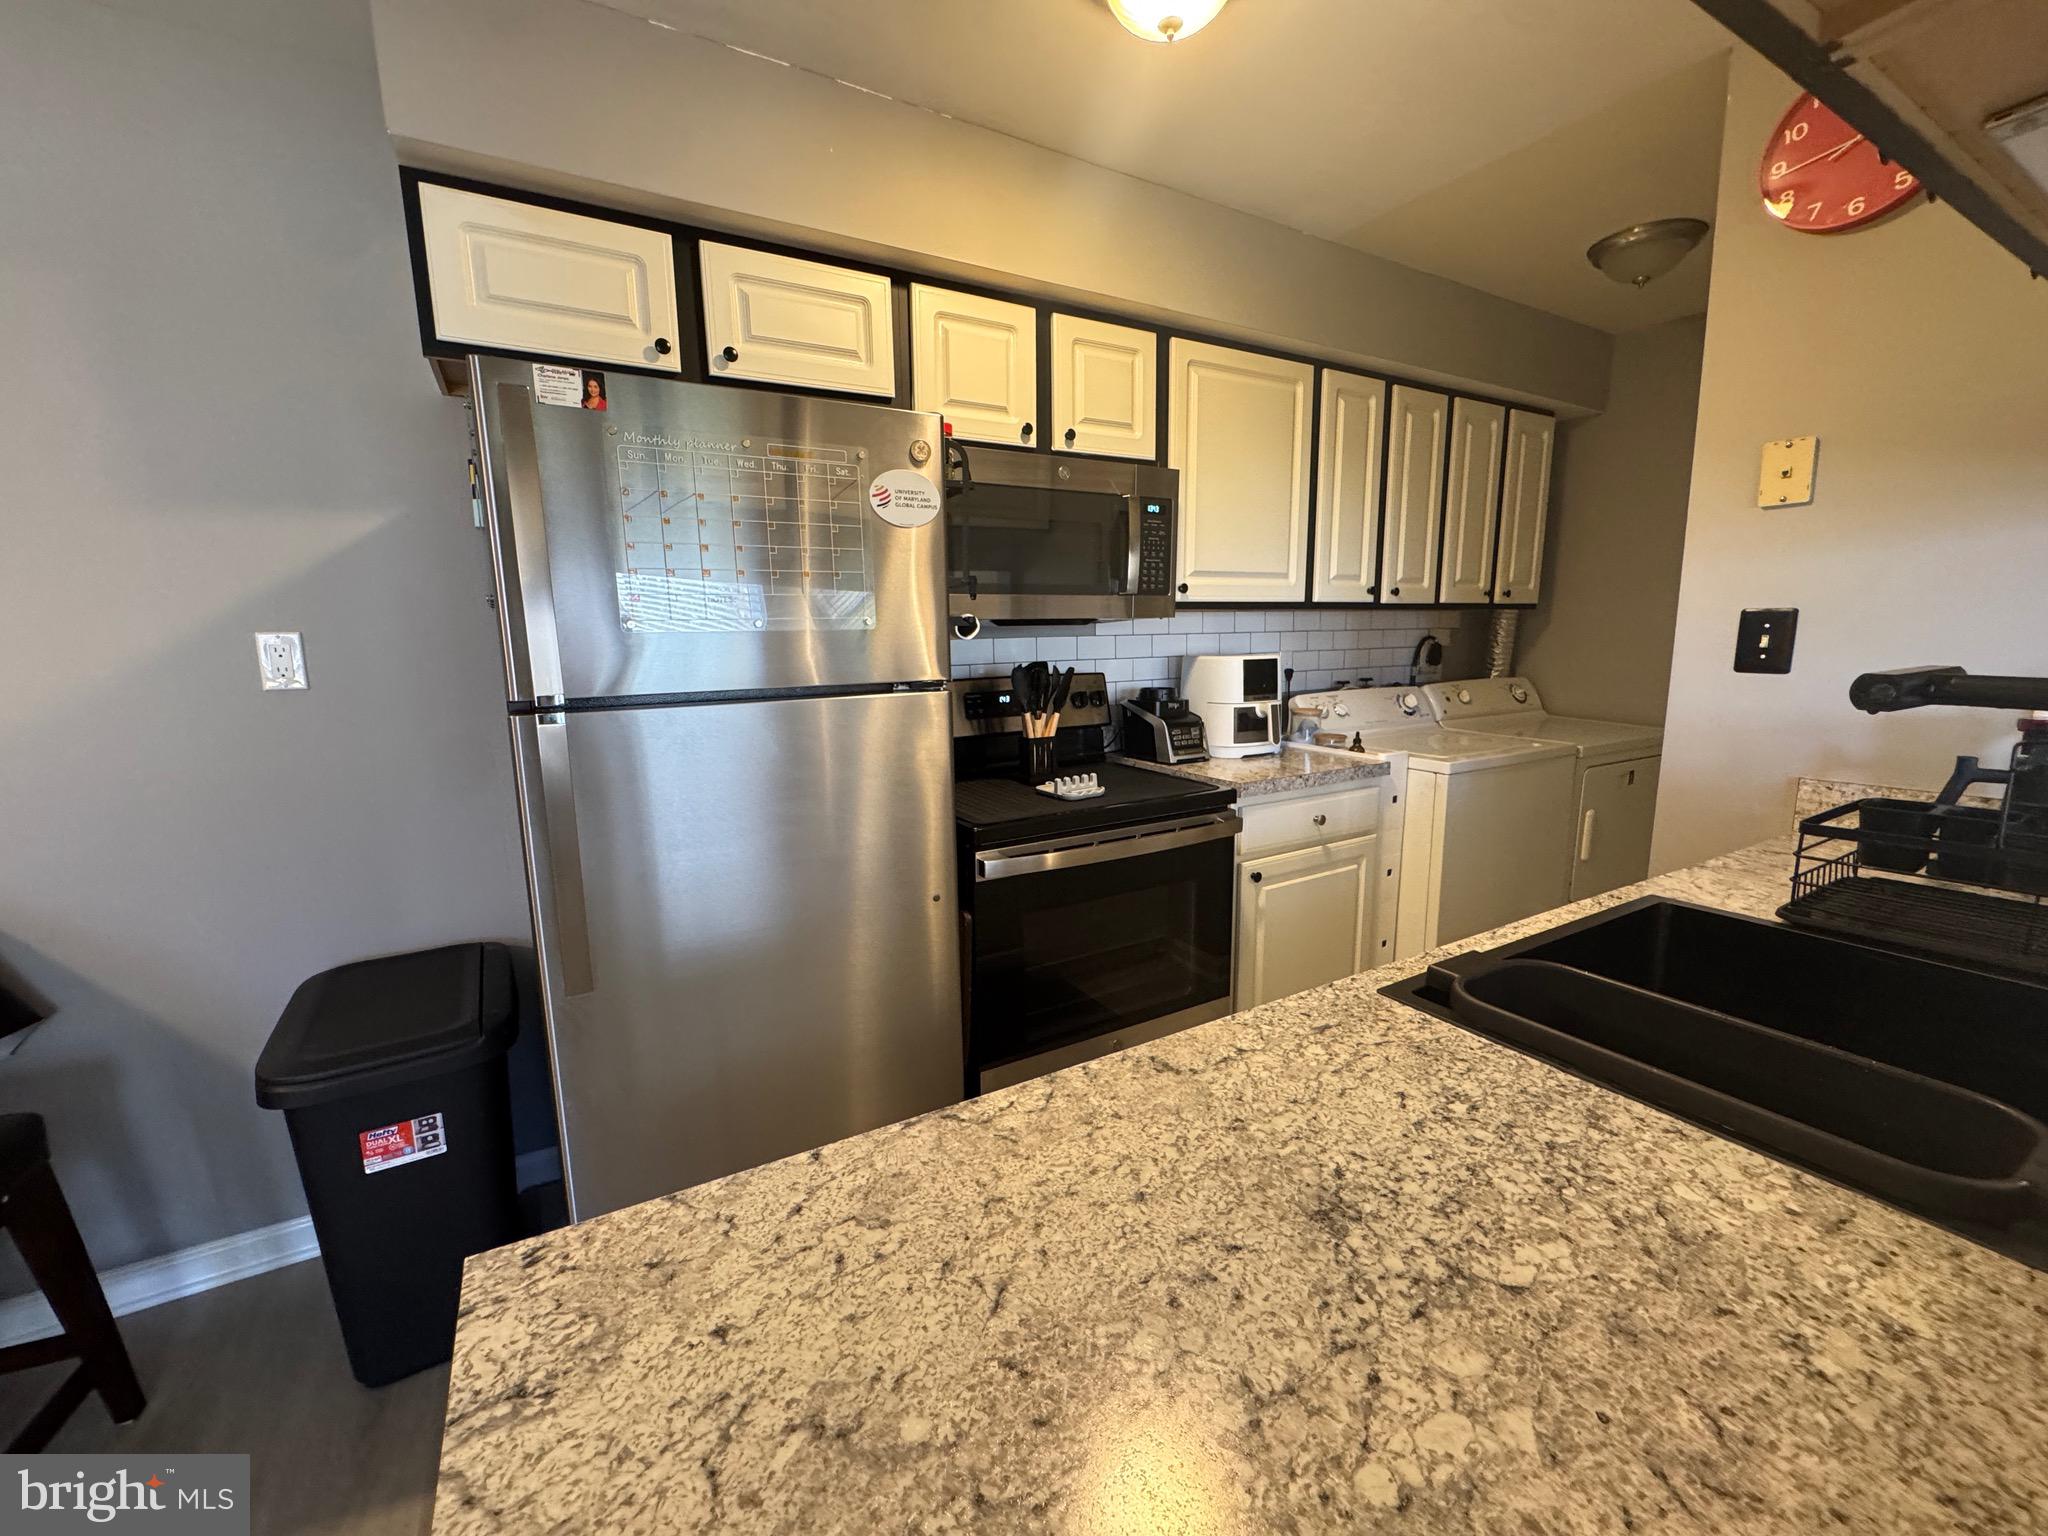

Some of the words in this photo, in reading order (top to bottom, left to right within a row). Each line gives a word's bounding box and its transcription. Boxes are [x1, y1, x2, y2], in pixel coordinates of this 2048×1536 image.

[1783, 122, 1809, 145] 10
[1768, 161, 1788, 180] 9
[1894, 170, 1914, 190] 5
[1780, 190, 1795, 206] 8
[1847, 196, 1865, 216] 6
[1807, 202, 1823, 222] 7
[623, 431, 681, 449] Monthly
[686, 440, 737, 451] planner
[368, 1128, 397, 1140] Hefty
